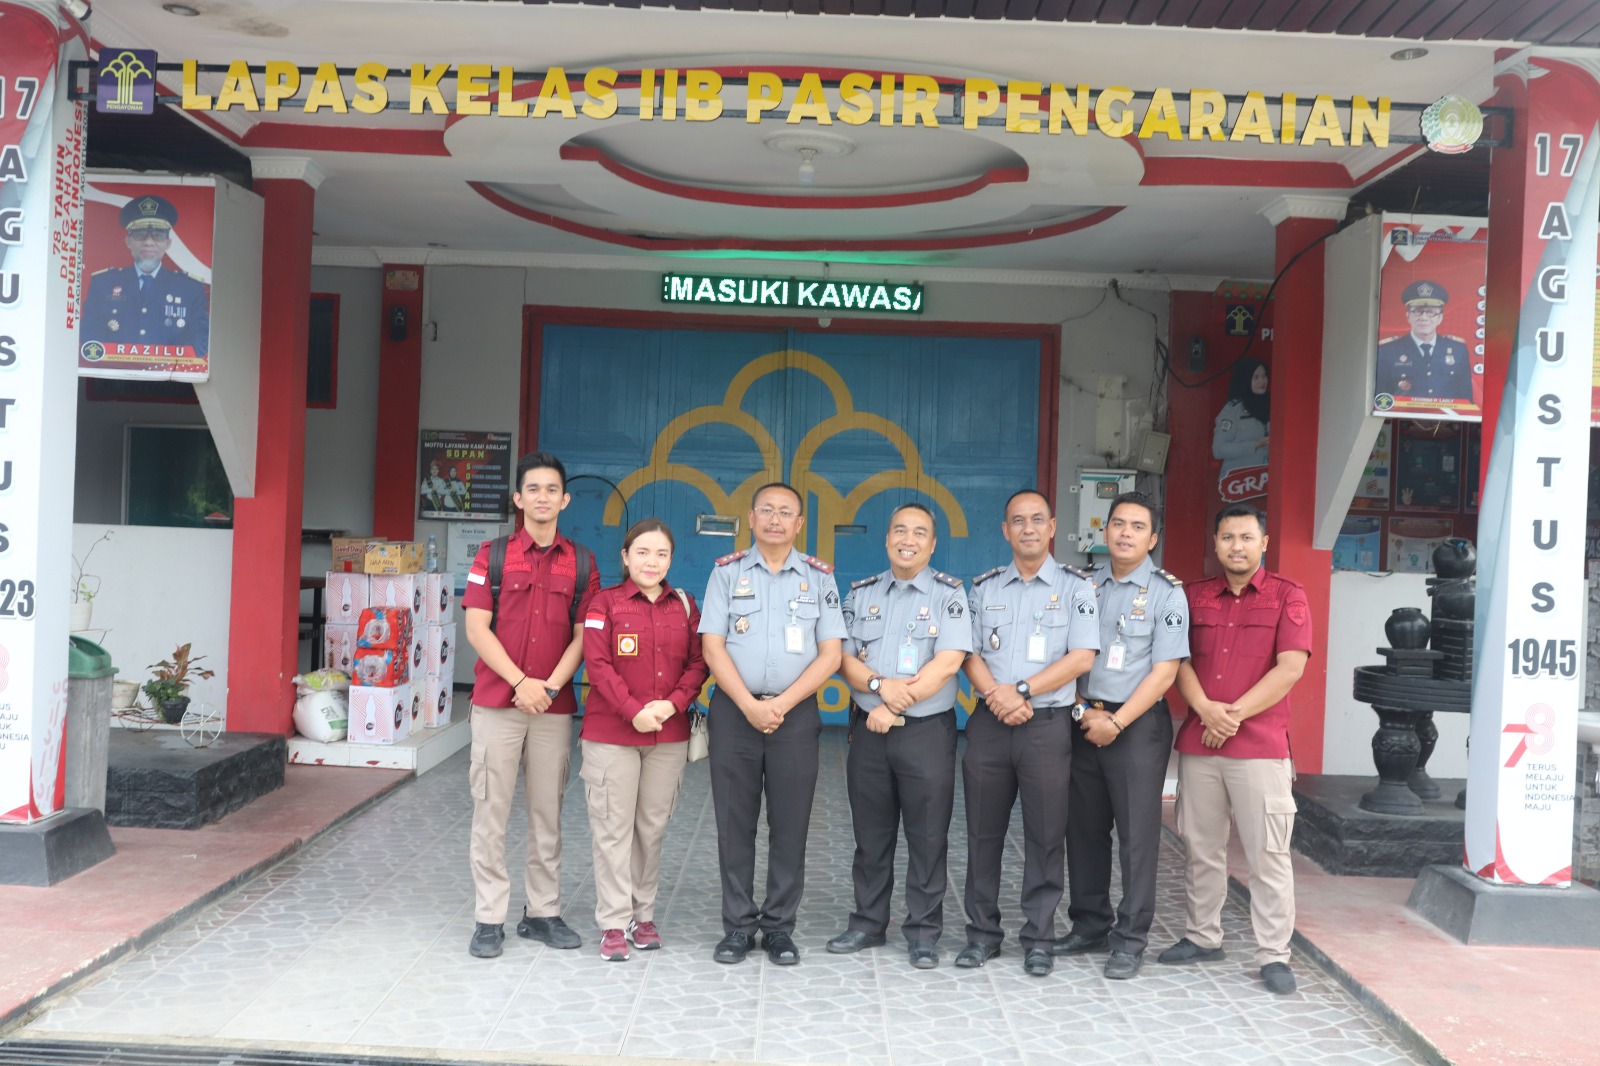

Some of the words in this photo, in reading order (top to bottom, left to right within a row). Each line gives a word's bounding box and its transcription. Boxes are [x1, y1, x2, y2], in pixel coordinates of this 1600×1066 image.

[0, 79, 37, 118] 7
[182, 59, 389, 114] LAPAS
[409, 62, 619, 119] KELAS
[639, 68, 724, 121] IIB
[746, 71, 940, 128] PASIR
[963, 78, 1391, 148] PENGARAIAN
[1536, 135, 1582, 175] 17
[54, 143, 65, 218] TAHUN
[60, 128, 73, 279] DIRGAHAYU
[53, 229, 61, 255] 78
[66, 217, 78, 330] REPUBLIK
[75, 248, 83, 306] AGUSTUS
[117, 344, 185, 356] RAZILU
[1532, 203, 1571, 614] AGUSTUS
[446, 449, 485, 459] SOPAN
[351, 546, 363, 554] Day
[1508, 638, 1577, 677] 1945
[1526, 774, 1565, 782] MELAJU
[1527, 763, 1557, 771] TERUS
[1525, 783, 1558, 791] UNTUK
[1525, 793, 1575, 802] INDONESIA
[1525, 803, 1552, 811] MAJU
